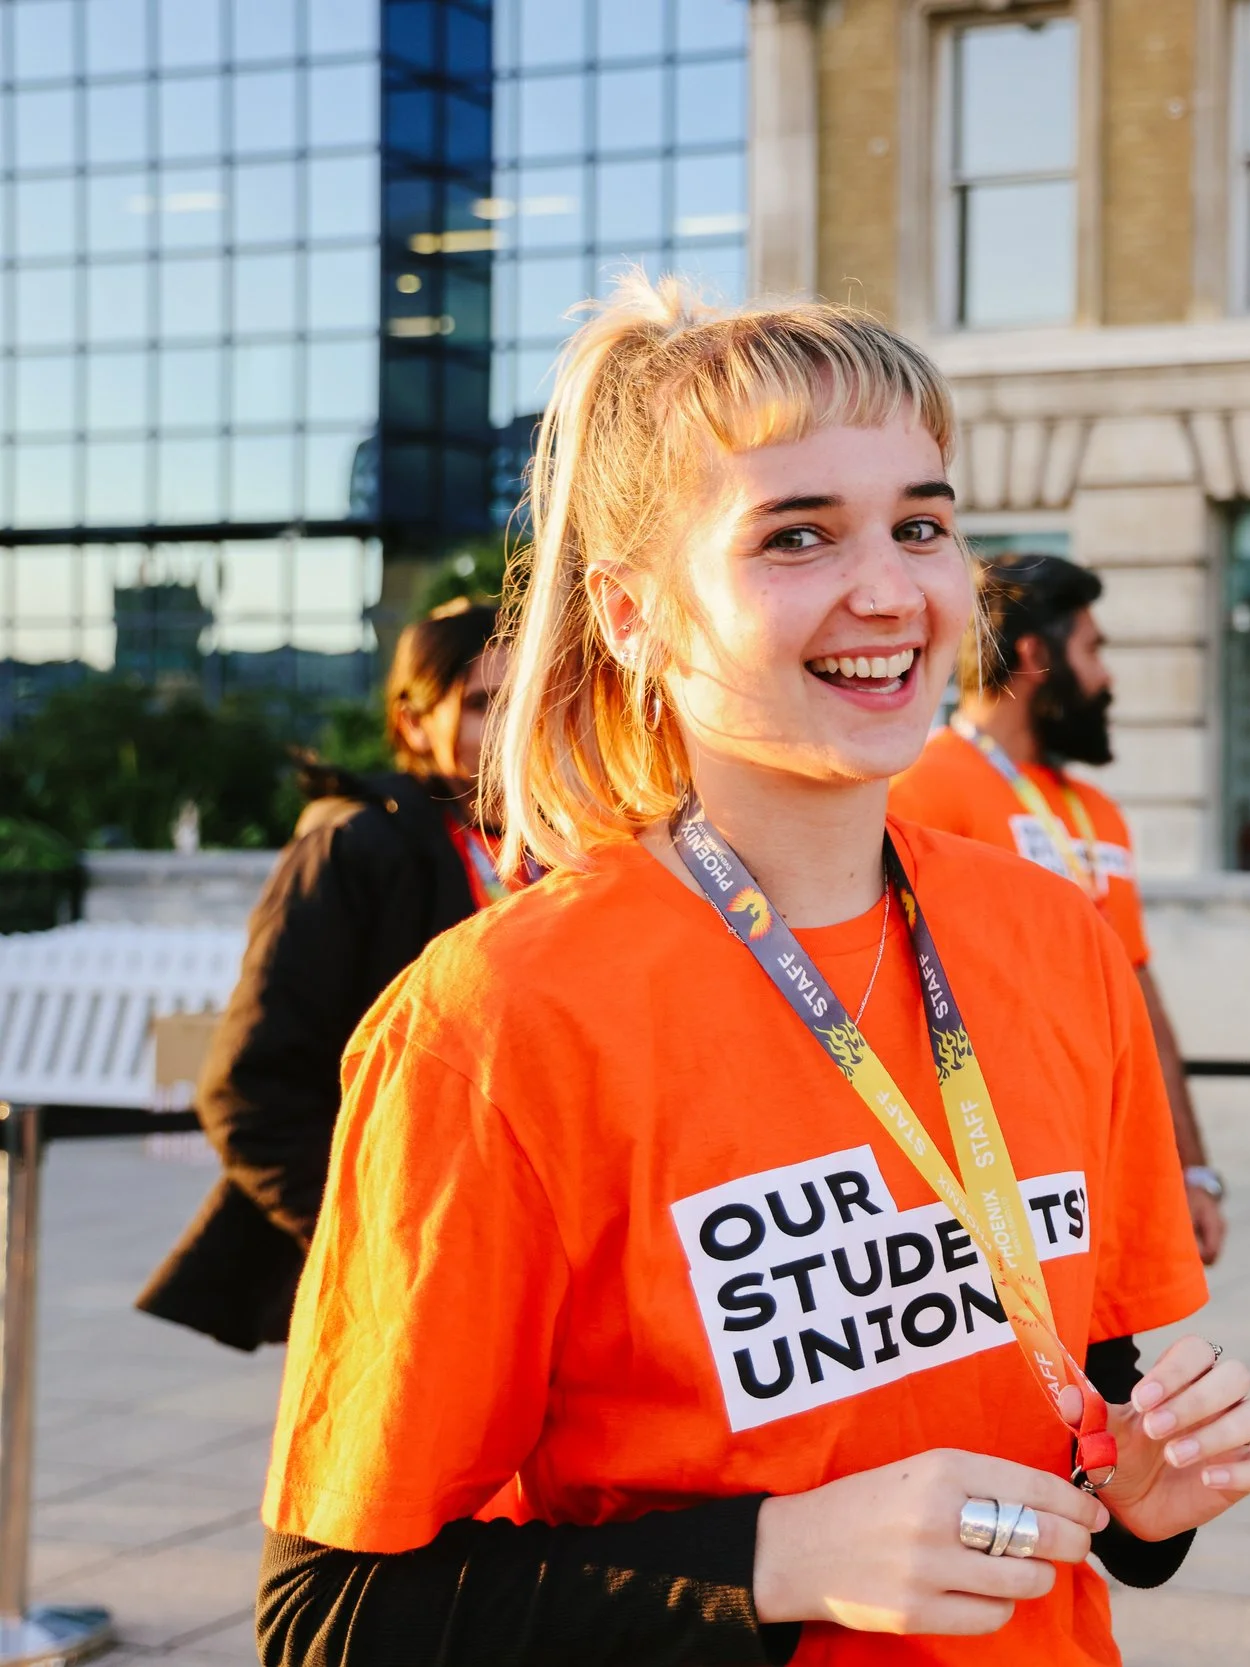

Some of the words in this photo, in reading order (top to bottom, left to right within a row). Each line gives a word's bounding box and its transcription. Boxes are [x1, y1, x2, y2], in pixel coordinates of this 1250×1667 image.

[681, 821, 734, 892] PHOENIX
[777, 952, 828, 1018] STAFF
[918, 953, 949, 1019] STAFF
[876, 1090, 926, 1157] STAFF
[960, 1099, 996, 1168] STAFF
[699, 1170, 884, 1261] OUR
[717, 1187, 1086, 1332] STUDETS'
[733, 1274, 1008, 1400] UNION
